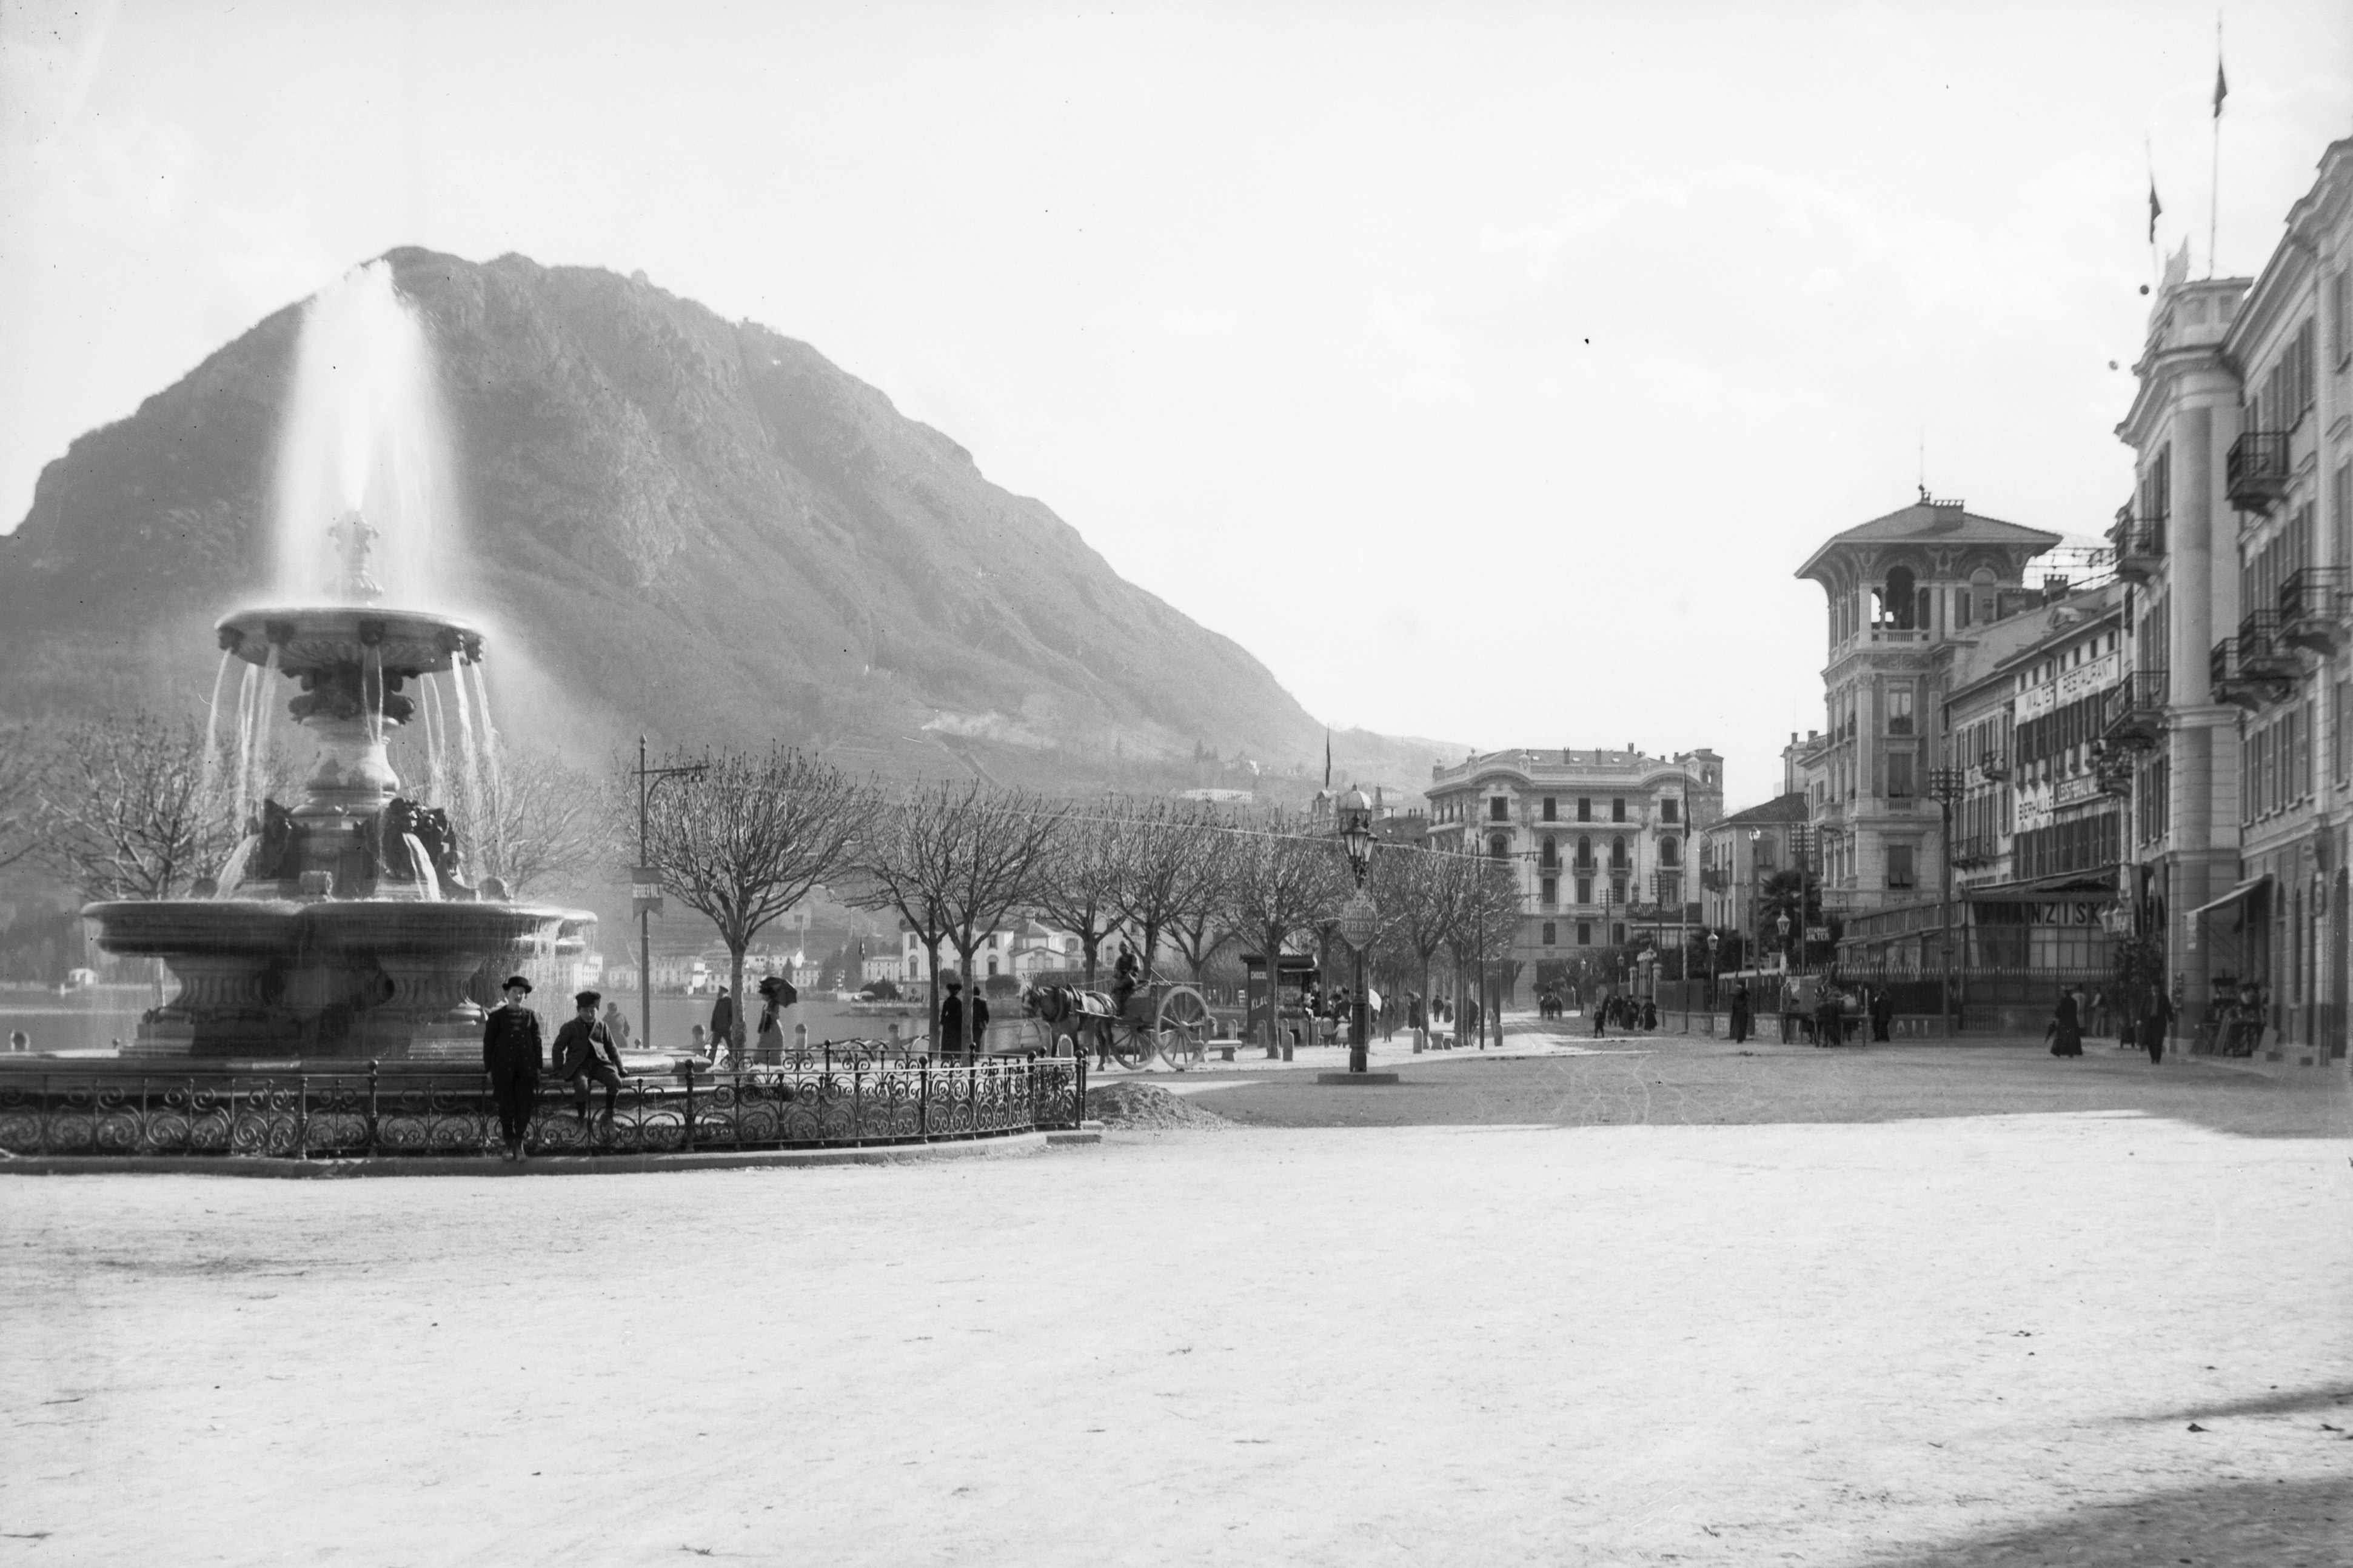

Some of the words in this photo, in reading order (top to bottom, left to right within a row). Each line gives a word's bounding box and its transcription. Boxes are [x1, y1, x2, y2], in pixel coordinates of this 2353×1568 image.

[2062, 657, 2114, 695] RESTAURANT
[1345, 908, 1372, 919] CHOCOLAT
[1344, 921, 1374, 932] FREY
[1347, 932, 1369, 941] AARAU
